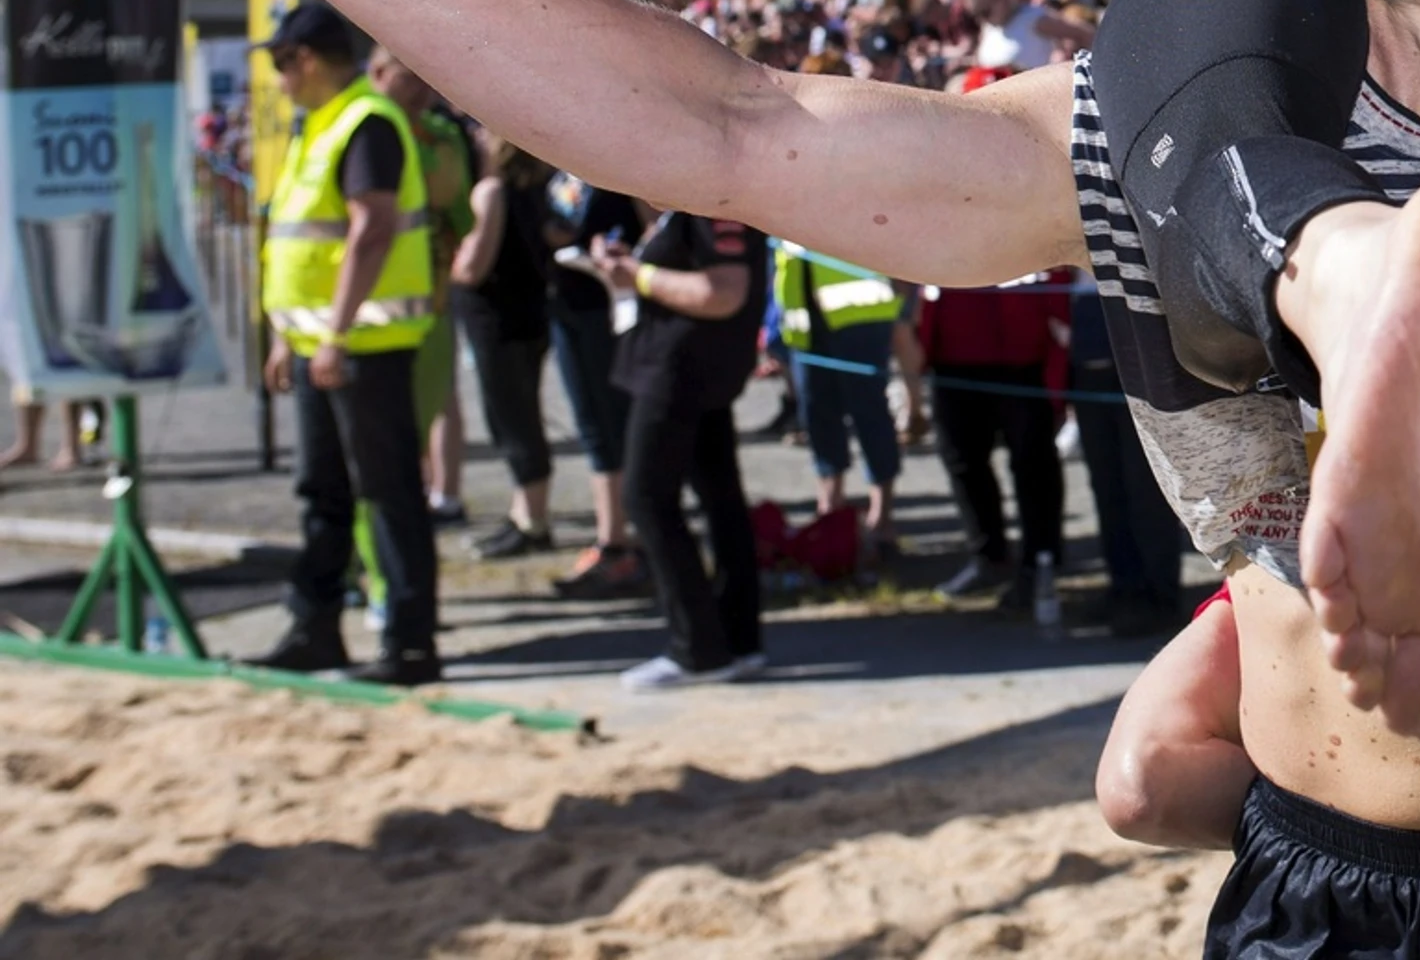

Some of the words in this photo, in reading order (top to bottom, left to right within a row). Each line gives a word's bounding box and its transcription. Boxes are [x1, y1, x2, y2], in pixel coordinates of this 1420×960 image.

[36, 130, 117, 177] 100
[1229, 501, 1262, 522] THEN
[1267, 508, 1292, 521] YOU
[1261, 527, 1290, 539] ANY
